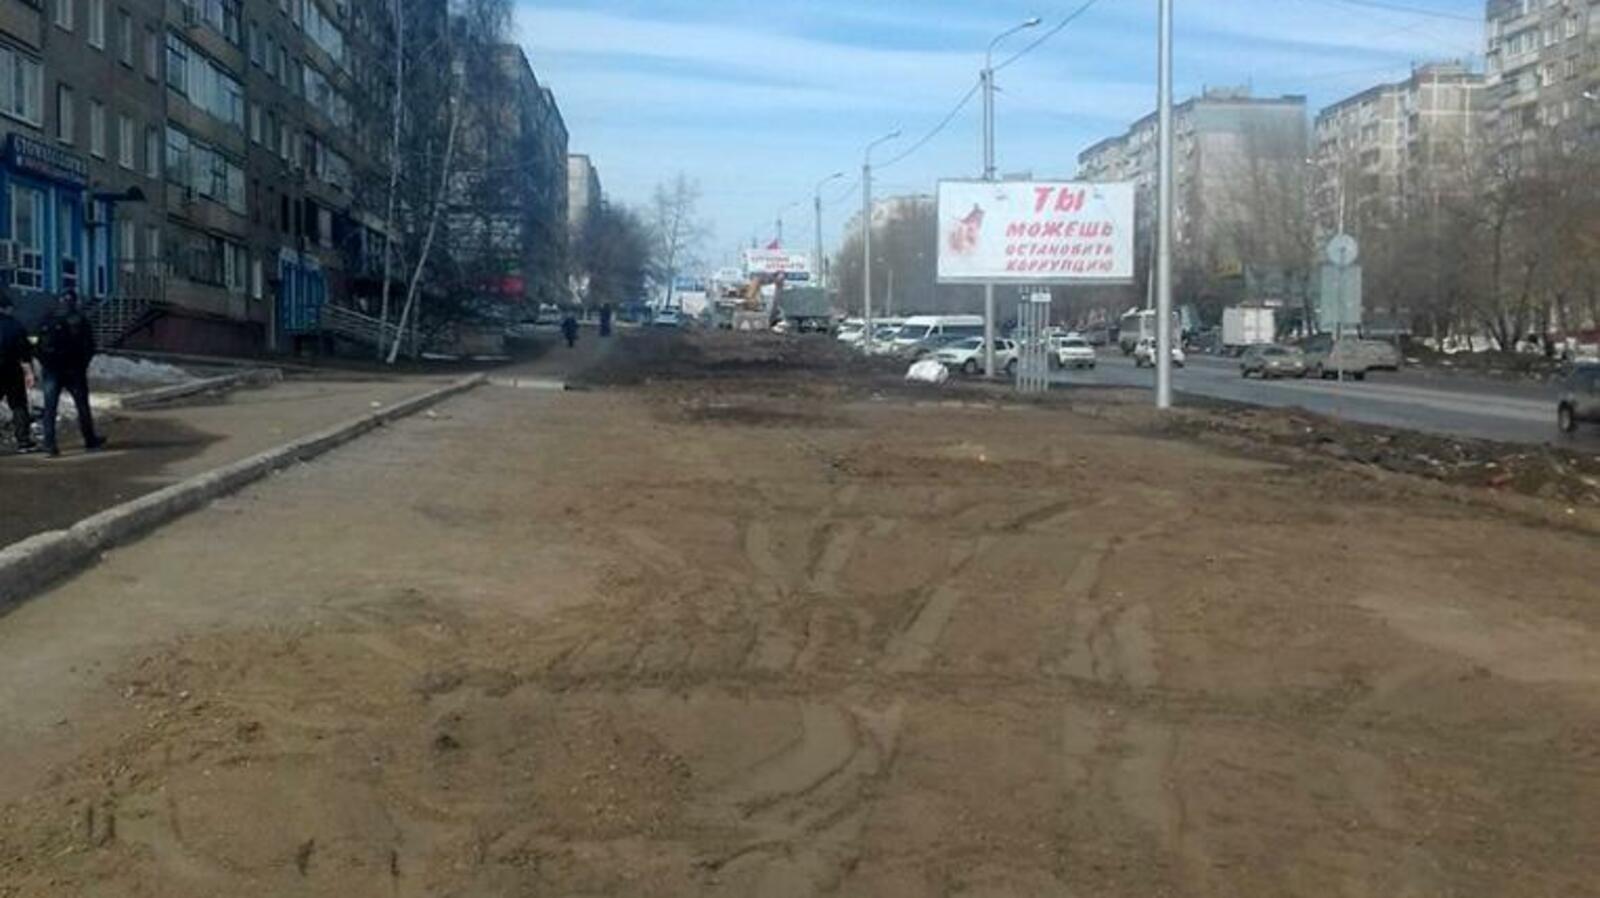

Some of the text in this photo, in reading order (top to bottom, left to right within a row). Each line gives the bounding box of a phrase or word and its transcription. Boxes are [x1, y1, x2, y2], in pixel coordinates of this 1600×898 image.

[1034, 186, 1085, 213] ТЫ
[1005, 221, 1113, 238] МОЖЕШЬ
[1005, 243, 1113, 256] ОСТАНОВИТЬ
[1005, 259, 1113, 273] КОРРУПЦИЮ
